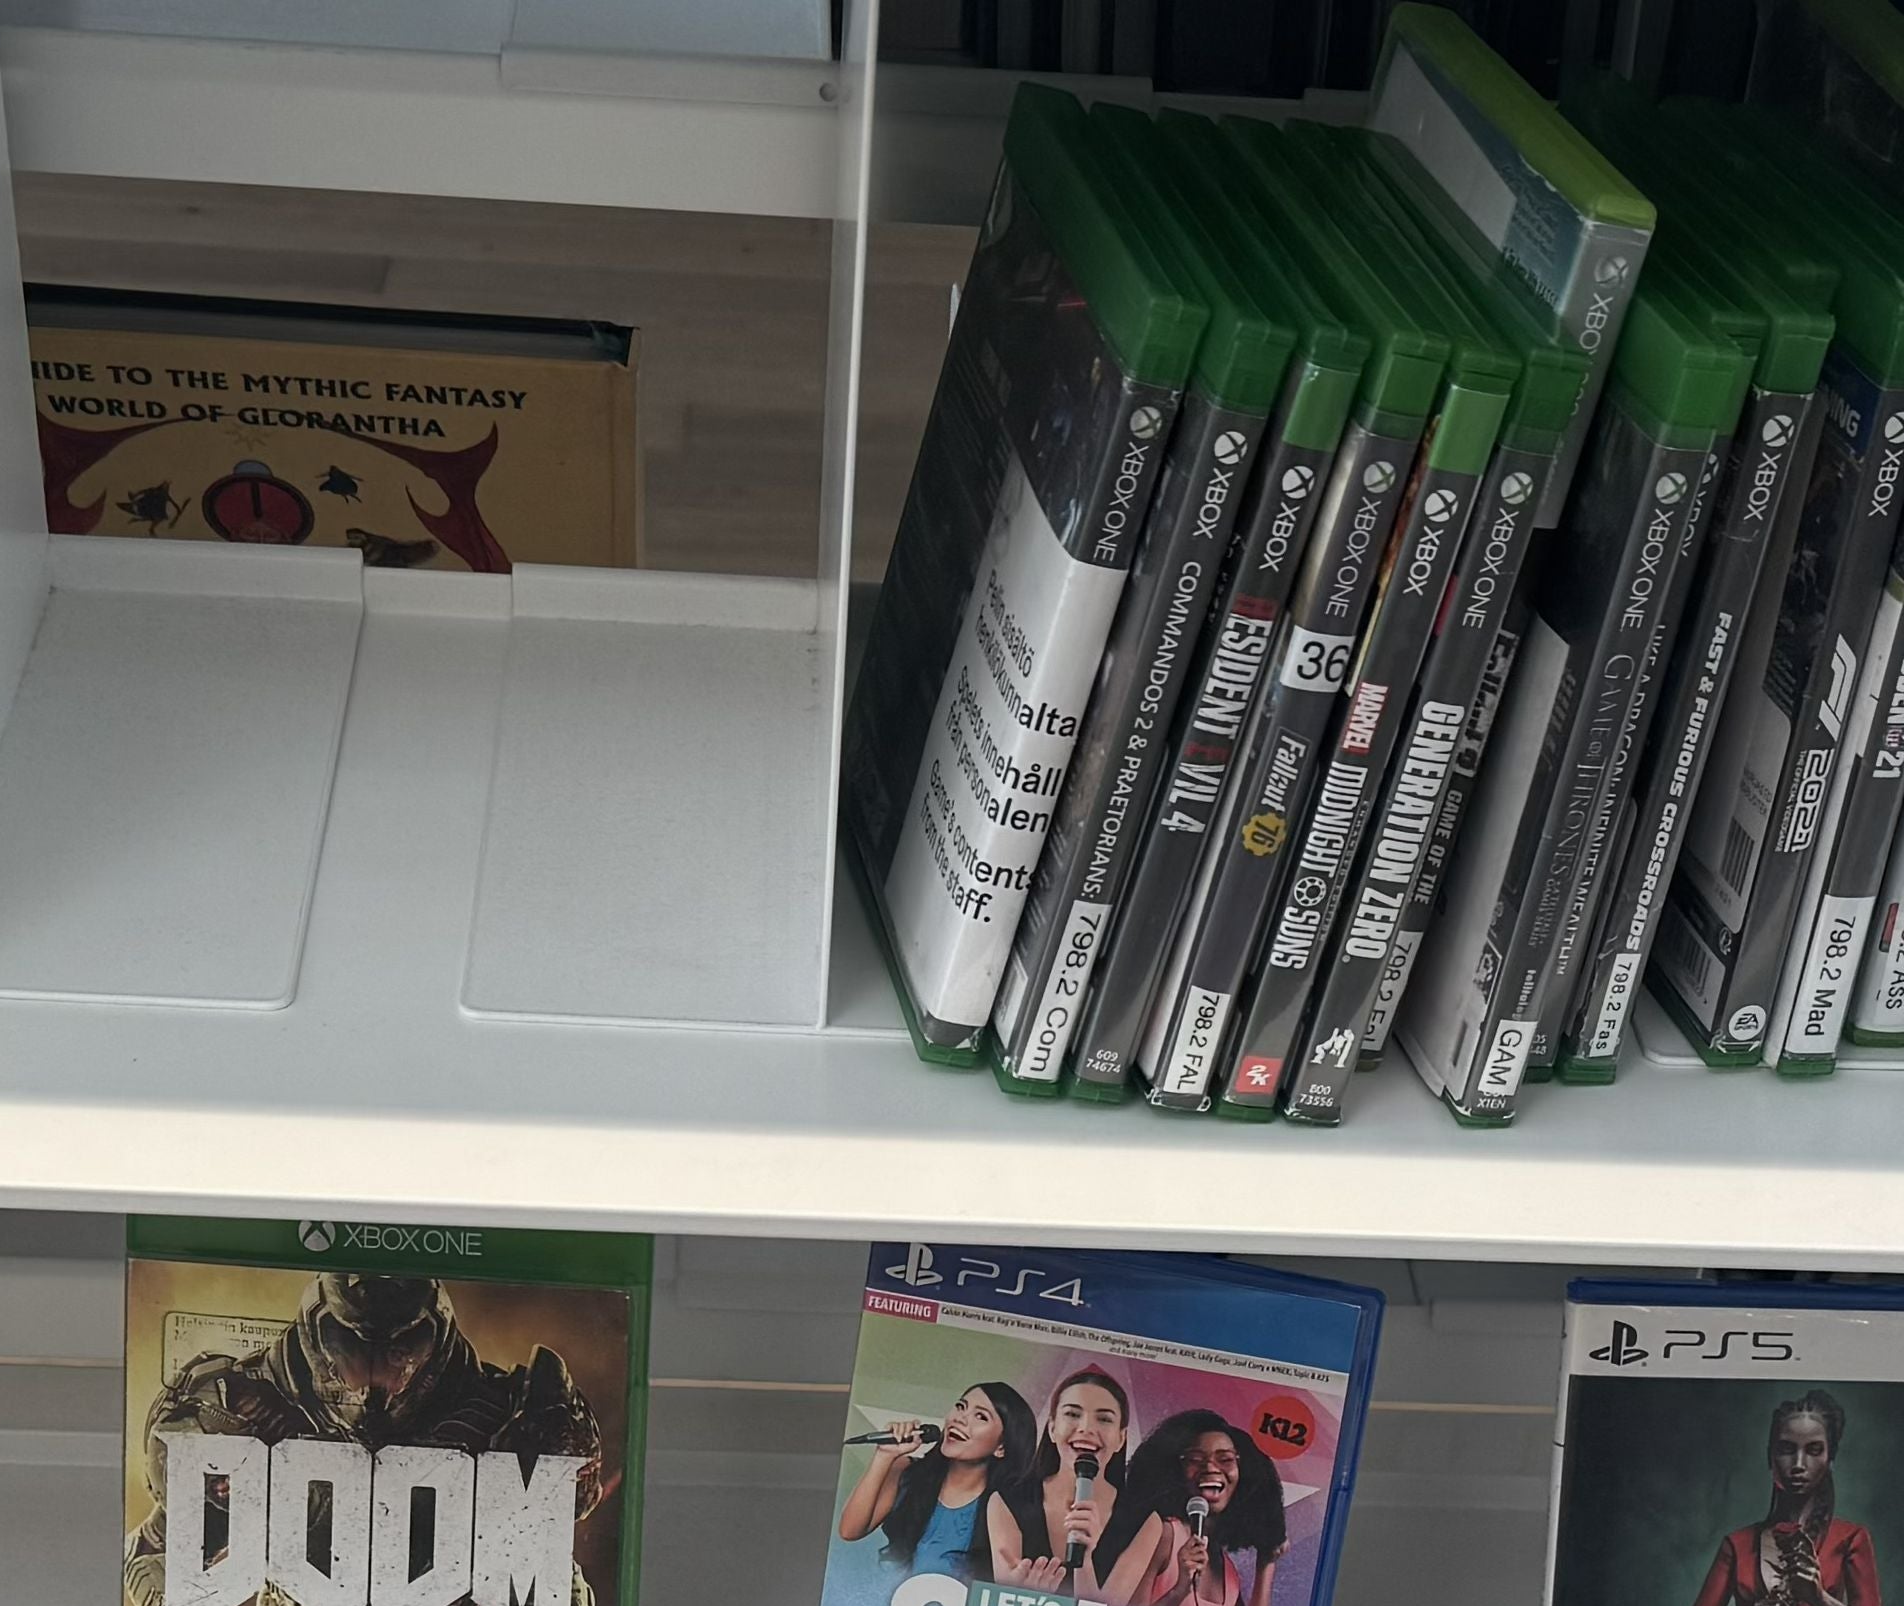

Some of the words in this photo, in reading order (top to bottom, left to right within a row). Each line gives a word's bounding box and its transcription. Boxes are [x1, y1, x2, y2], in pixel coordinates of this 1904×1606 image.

[107, 364, 153, 387] TO
[165, 368, 229, 391] THE
[244, 373, 371, 401] MYTHIC
[386, 381, 527, 411] FANTASY
[48, 394, 168, 420] WORLD
[181, 402, 225, 423] OF
[238, 405, 447, 438] GLORANTHA
[1744, 453, 1782, 521] XBOX
[1868, 450, 1903, 518] XBOX
[1140, 562, 1202, 713] COMMANDOS
[1296, 640, 1349, 683] 36
[1706, 611, 1732, 674] FAST
[1698, 676, 1714, 693] &
[1129, 734, 1147, 749] &
[1133, 718, 1153, 730] 2
[1342, 682, 1389, 754] MARVEL
[984, 723, 1062, 798] innehåll
[1669, 697, 1709, 797] FURIOUS
[1873, 750, 1904, 778] 21
[1375, 700, 1465, 880] GENERATION
[1439, 790, 1462, 840] GAME
[1081, 756, 1143, 898] PRAETORIANS:
[1428, 843, 1446, 870] OF
[1626, 803, 1678, 950] CROSSROADS
[946, 873, 991, 923] staff.
[1420, 873, 1437, 905] THE
[1348, 887, 1405, 960] ZERO
[1056, 913, 1101, 996] 798.2
[1030, 1008, 1068, 1073] Com
[868, 1296, 932, 1318] FEATURING
[1664, 1330, 1794, 1361] PS5
[1258, 1413, 1307, 1446] K12
